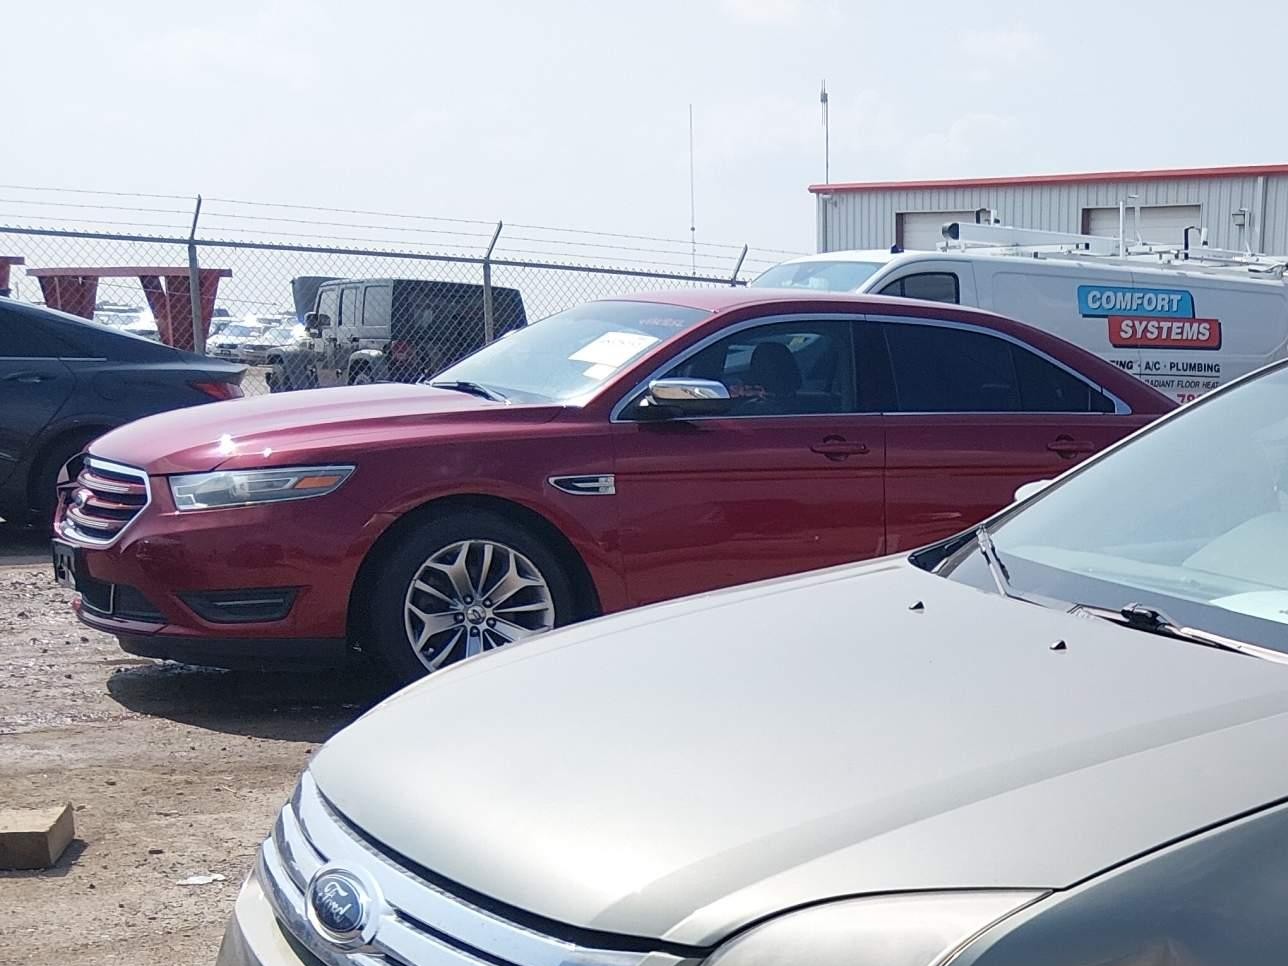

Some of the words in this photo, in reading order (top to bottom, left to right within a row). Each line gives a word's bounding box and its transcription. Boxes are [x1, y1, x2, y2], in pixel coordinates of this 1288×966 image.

[1087, 290, 1181, 312] COMFORT
[1120, 319, 1211, 341] SYSTEMS
[1144, 360, 1161, 372] A/C
[1169, 361, 1221, 373] PLUMBING
[1176, 380, 1201, 389] FLOOR
[317, 881, 352, 922] Ford
